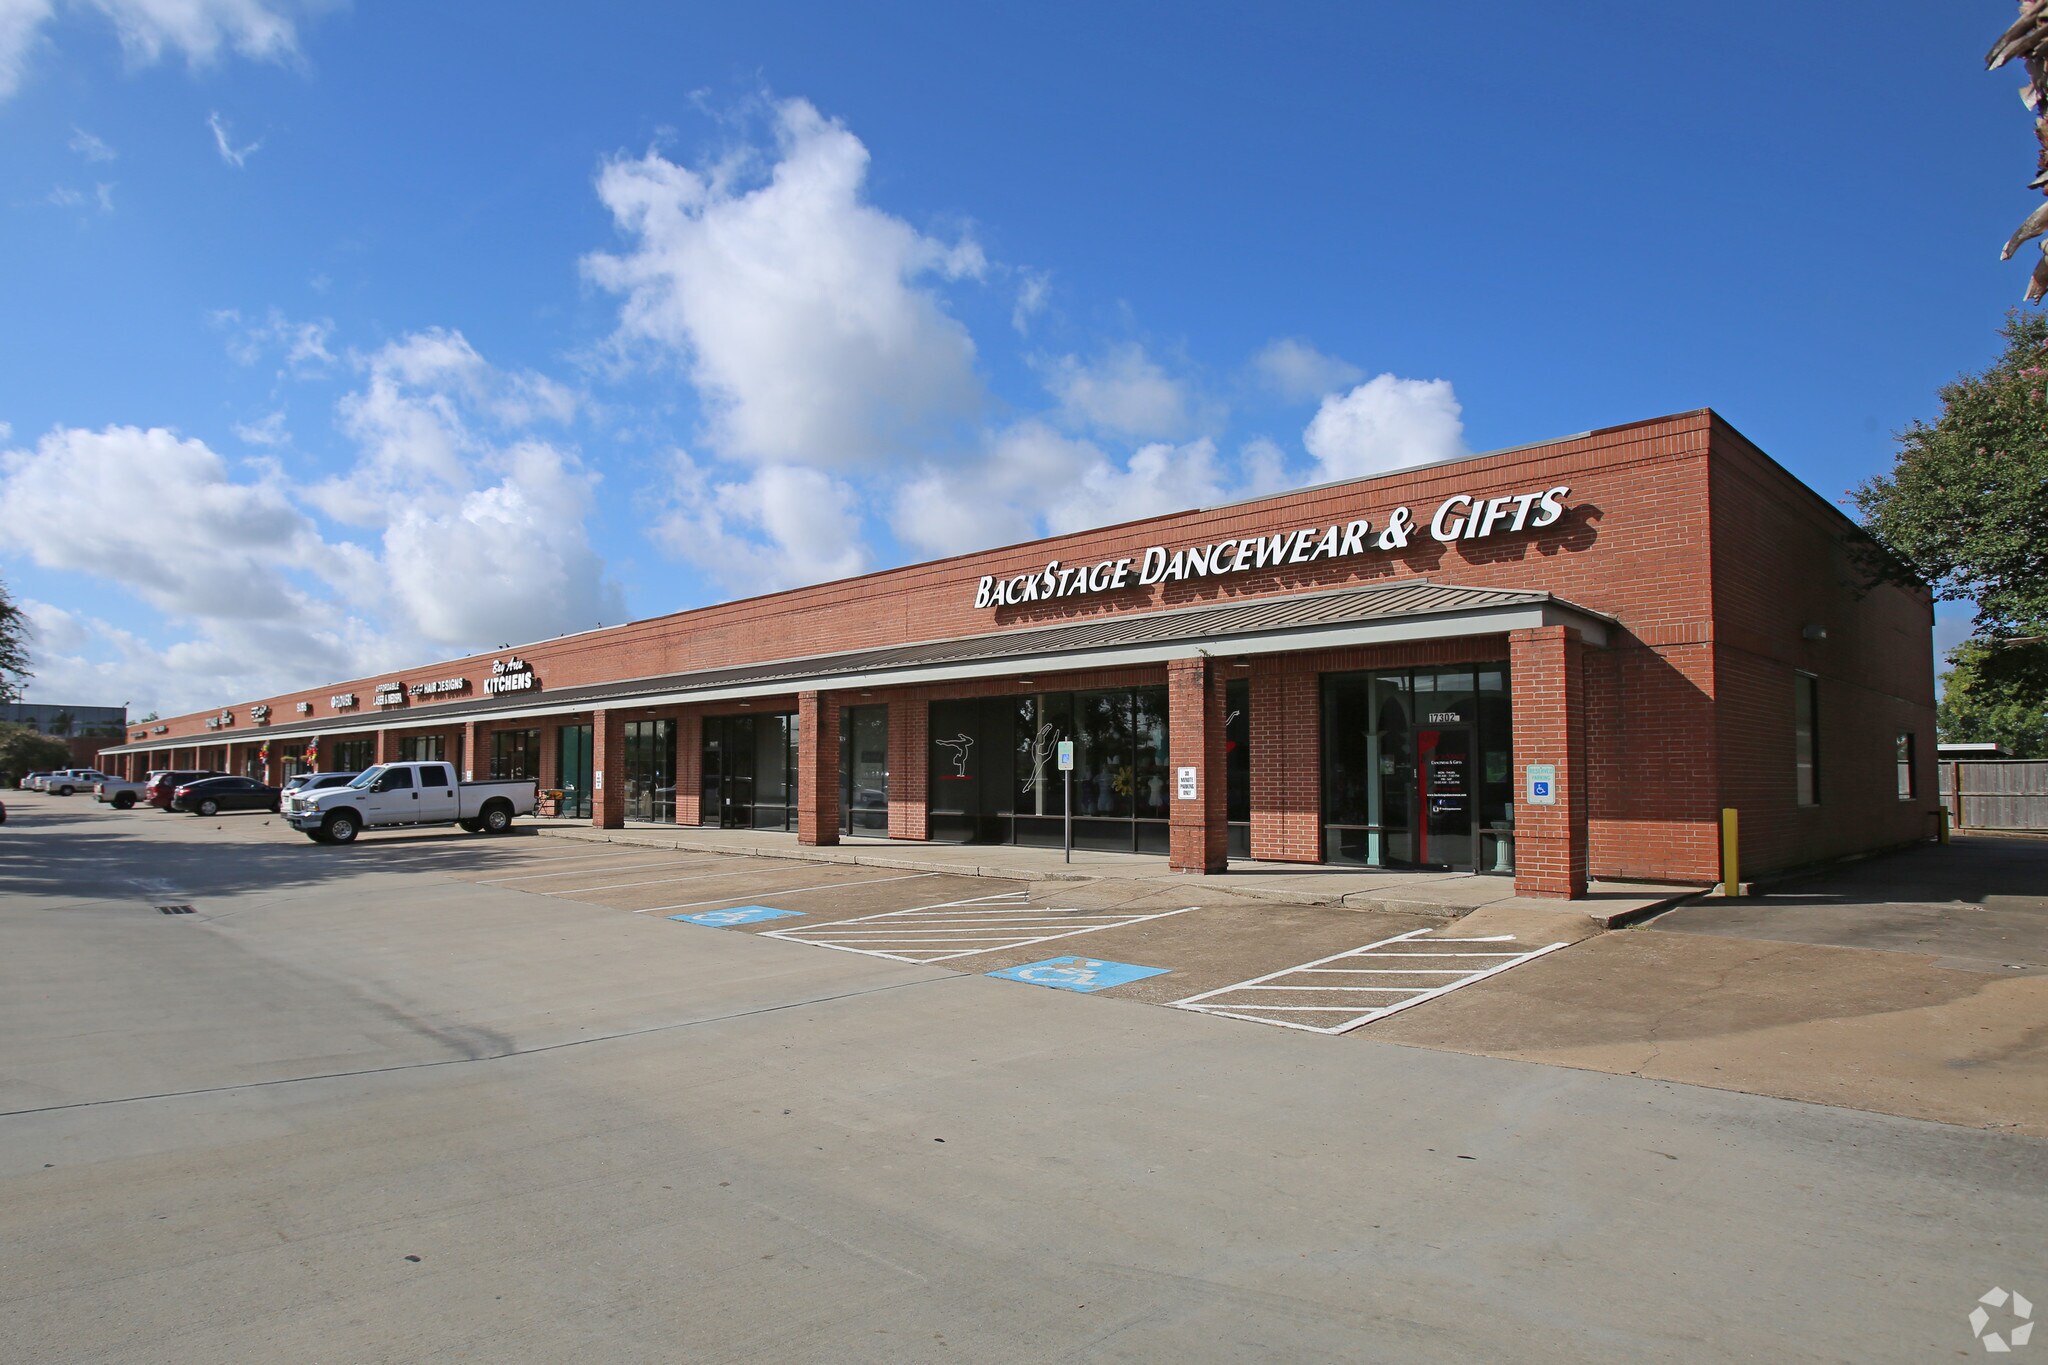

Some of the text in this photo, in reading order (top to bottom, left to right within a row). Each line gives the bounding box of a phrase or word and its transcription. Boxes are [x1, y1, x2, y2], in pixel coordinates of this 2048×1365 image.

[1138, 519, 1370, 586] DANCEWEAR
[1378, 506, 1415, 551] &
[1430, 486, 1571, 542] GIFTS
[423, 682, 437, 694] HAIR
[437, 677, 463, 692] DESIGNS
[483, 671, 532, 695] KITCHENS
[1429, 713, 1455, 722] 17302
